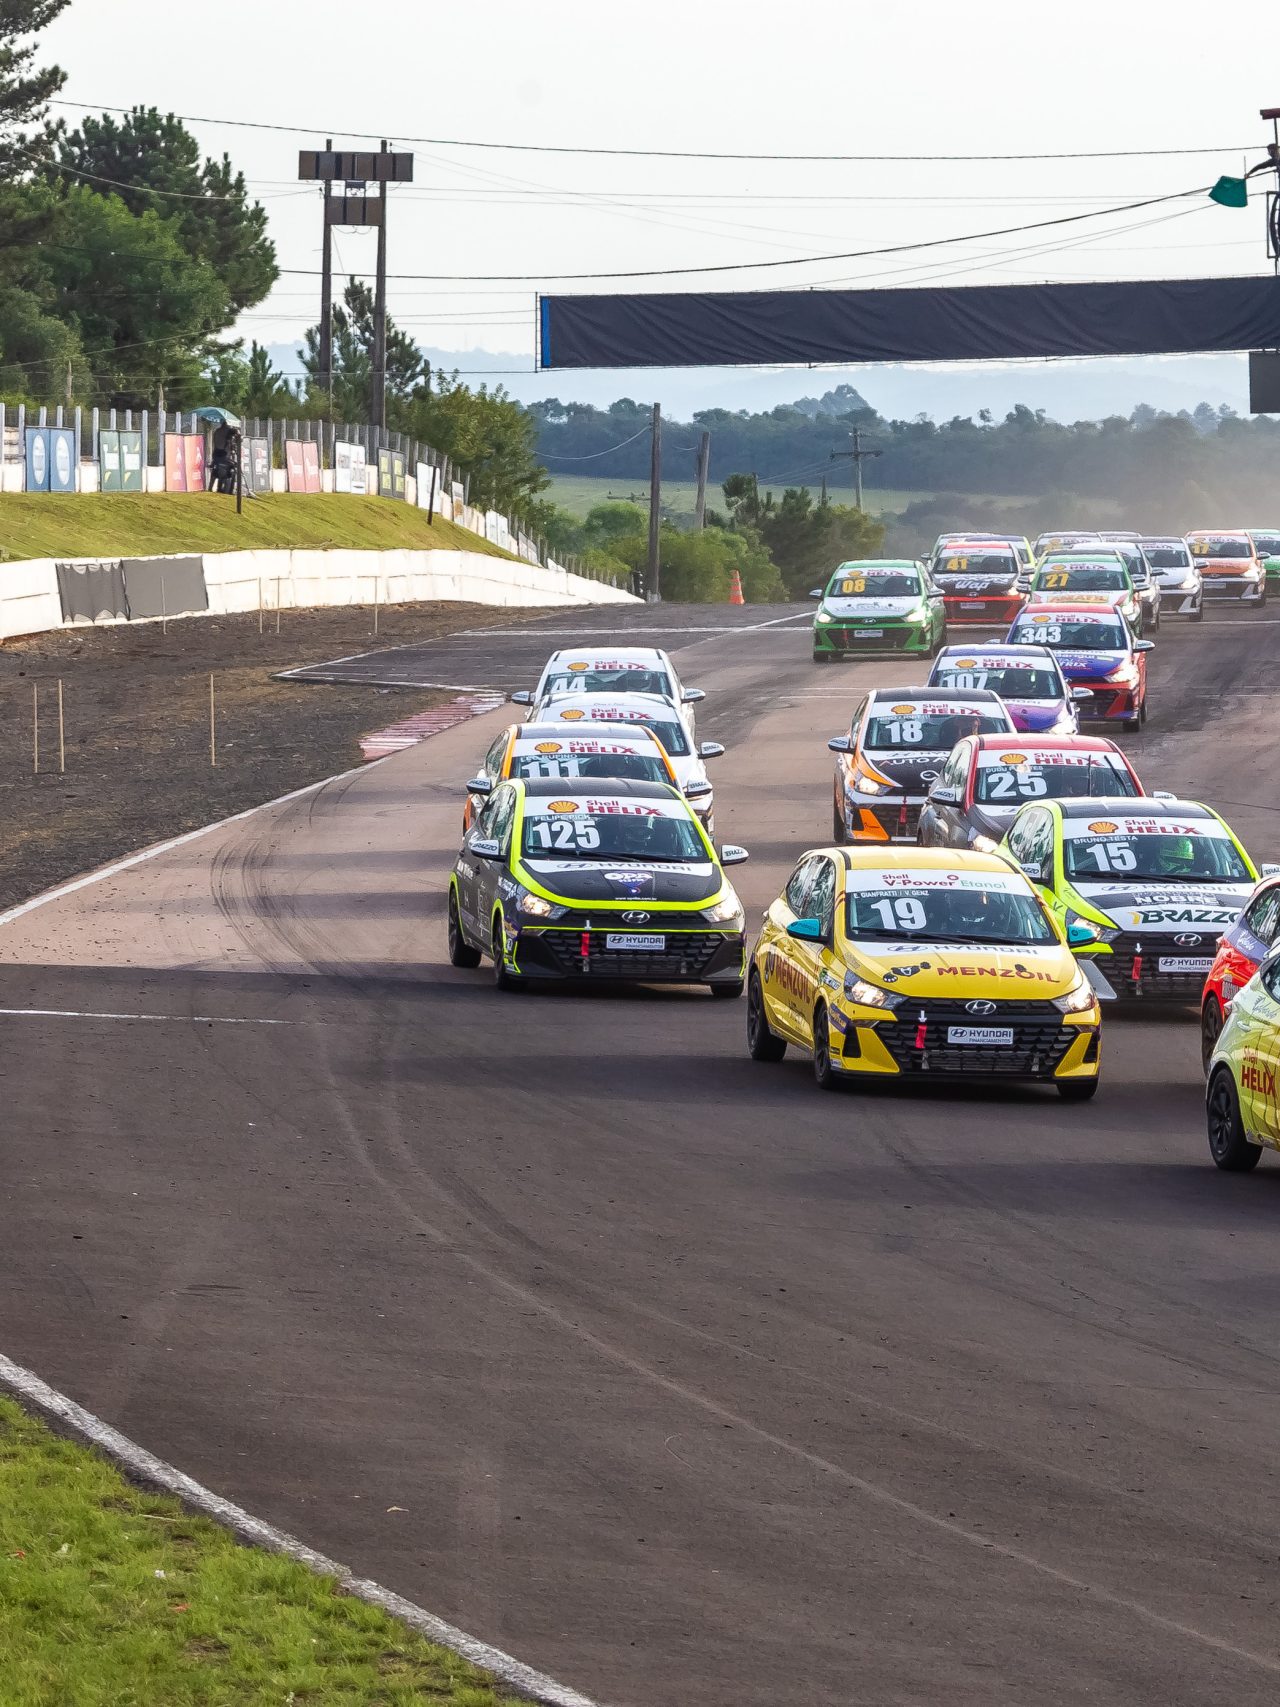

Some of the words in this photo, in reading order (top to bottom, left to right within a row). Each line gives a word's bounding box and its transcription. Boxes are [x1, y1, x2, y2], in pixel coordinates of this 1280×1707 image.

[842, 579, 866, 594] 08
[955, 580, 991, 591] Wap
[1021, 625, 1062, 644] 343
[594, 662, 649, 670] HELIX
[982, 661, 1035, 669] HELIX
[551, 676, 587, 693] 44
[591, 711, 655, 720] HELIX
[922, 706, 987, 716] HELIX
[885, 720, 924, 743] 18
[570, 744, 641, 755] HELIX
[1035, 756, 1105, 767] HELIX
[521, 760, 580, 778] 111
[987, 770, 1047, 799] 25
[587, 804, 667, 816] HELIX
[532, 820, 601, 849] 125
[1126, 824, 1205, 835] HELIX
[1073, 837, 1107, 845] BRUNO
[1085, 842, 1138, 872] 15
[599, 862, 691, 872] HYUNDAI
[884, 880, 956, 888] V-Power
[960, 879, 1007, 889] Etanol
[1140, 884, 1238, 893] HYUNDAI
[870, 898, 927, 930] 19
[626, 936, 664, 944] HYUNDAI
[933, 945, 1038, 955] HYUNDAI
[937, 964, 1062, 983] MENZOIL
[969, 1030, 1011, 1038] HYUNDAI
[1241, 1065, 1278, 1098] HELIX
